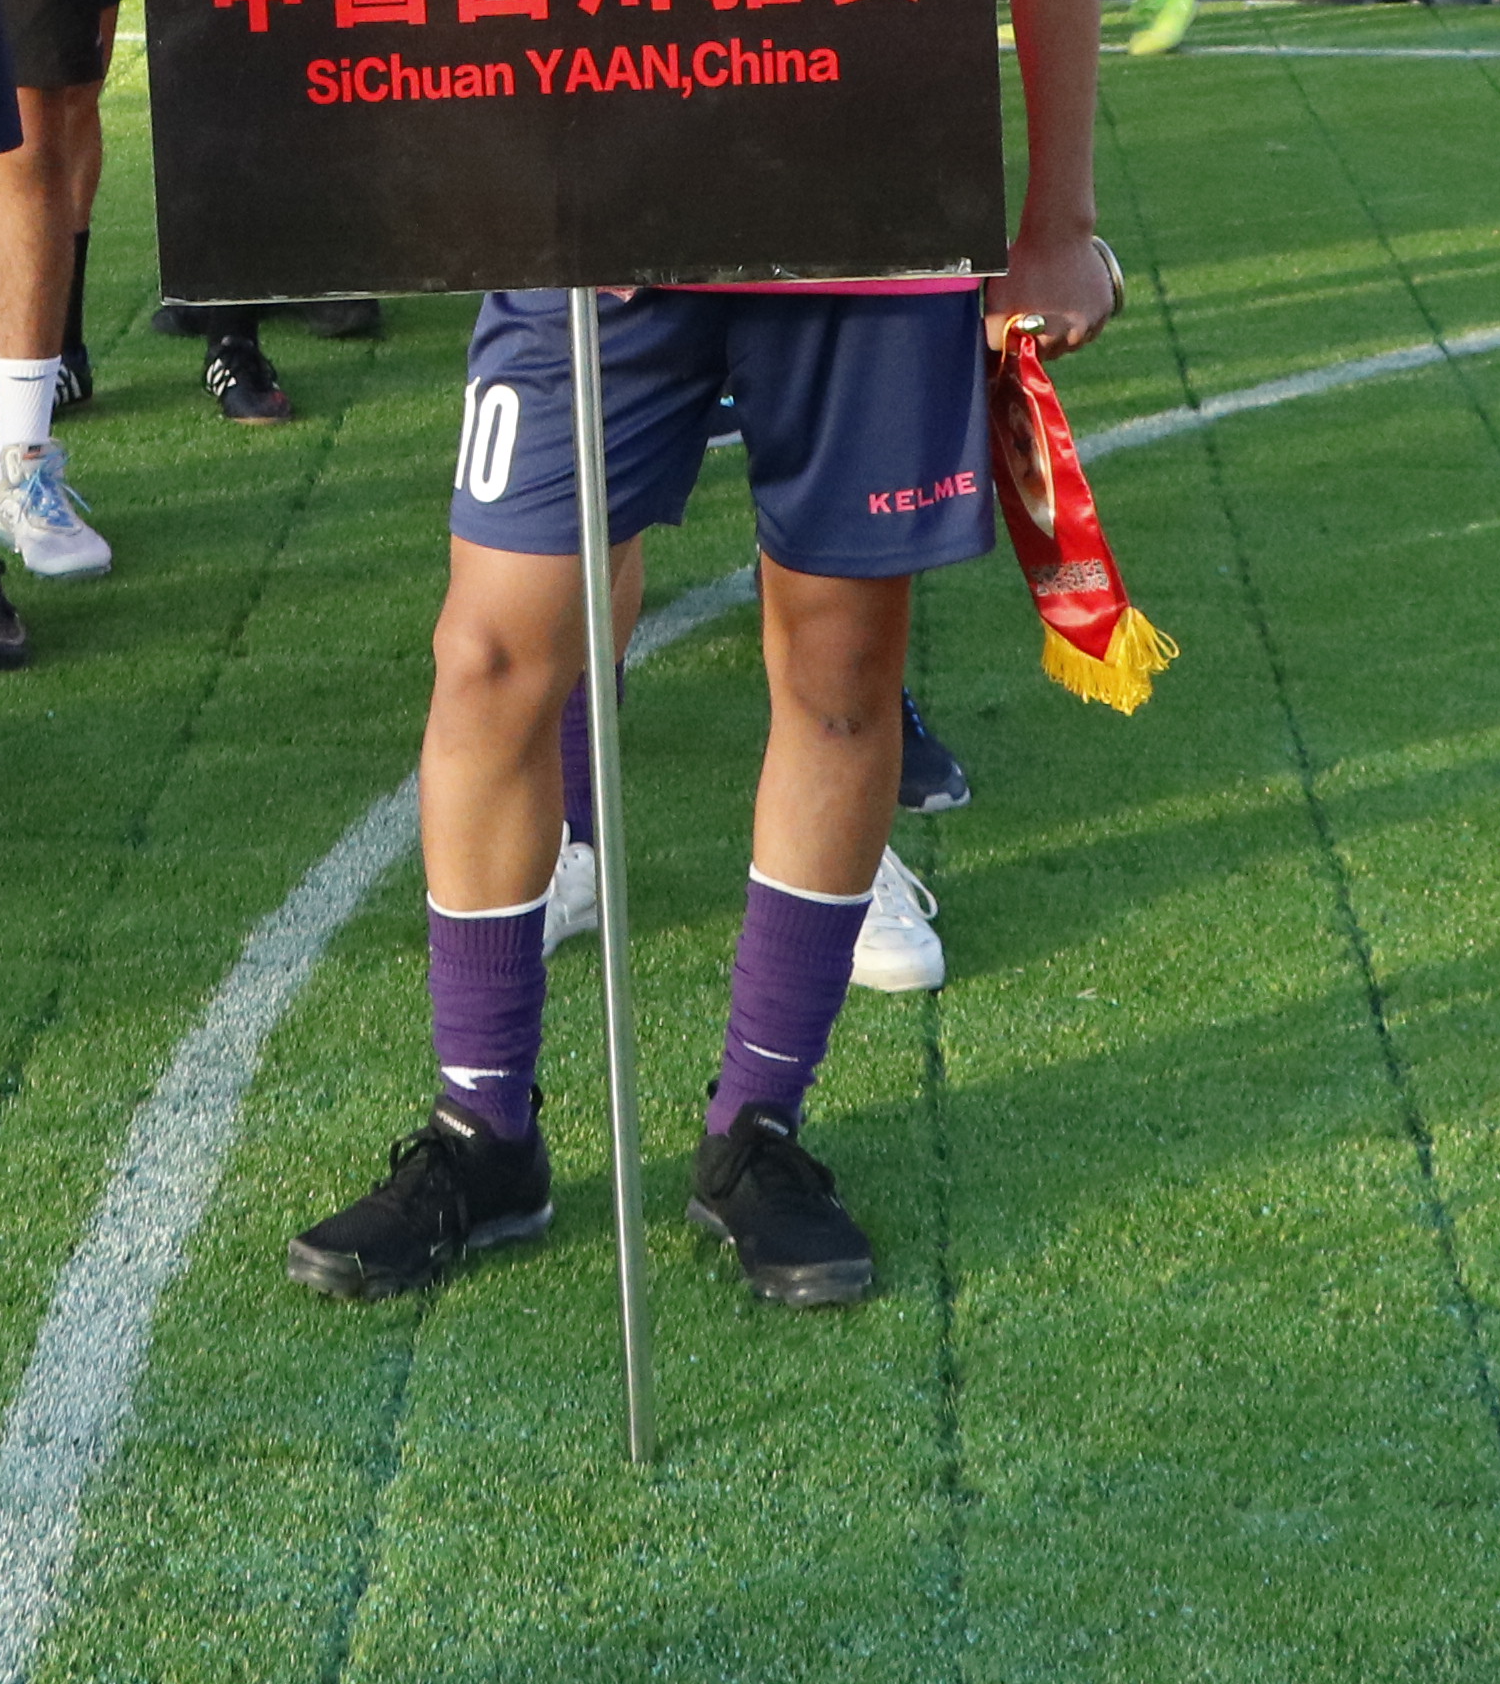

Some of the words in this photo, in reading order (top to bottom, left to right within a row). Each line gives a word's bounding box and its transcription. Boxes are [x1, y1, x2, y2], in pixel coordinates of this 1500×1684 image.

[307, 52, 515, 105] SiChuan
[525, 38, 840, 99] YAAN,China
[869, 471, 978, 515] KELME
